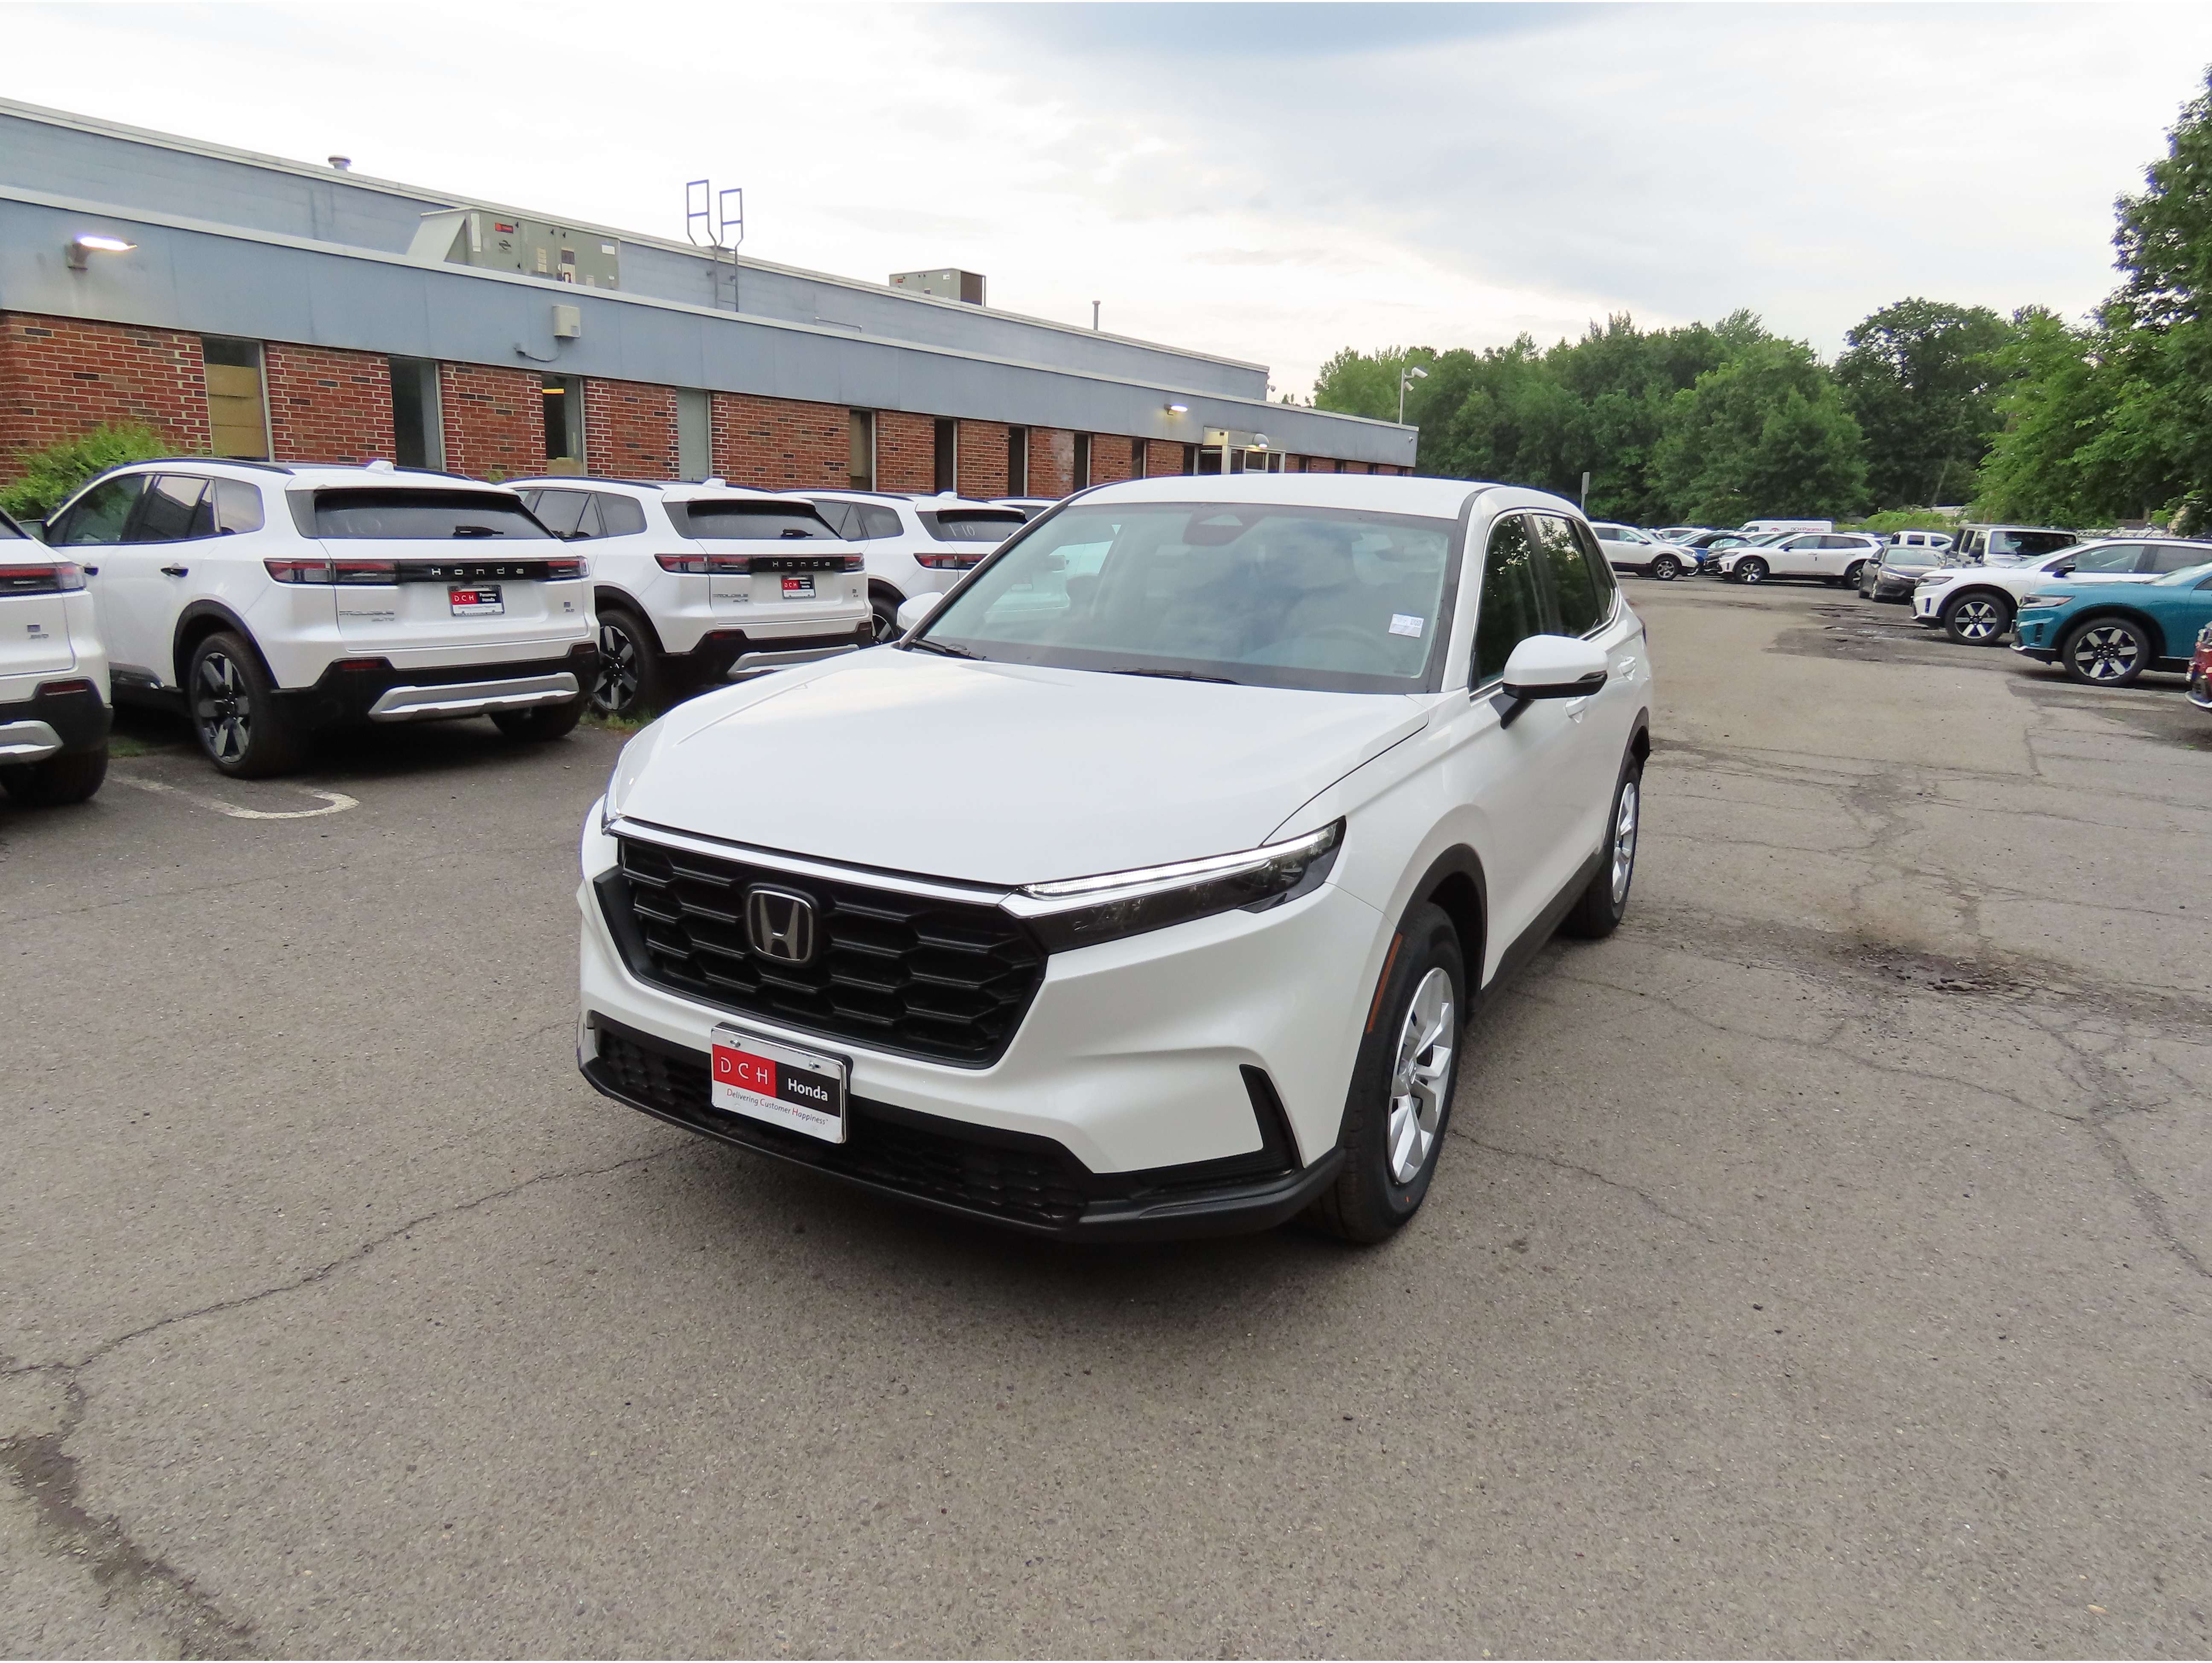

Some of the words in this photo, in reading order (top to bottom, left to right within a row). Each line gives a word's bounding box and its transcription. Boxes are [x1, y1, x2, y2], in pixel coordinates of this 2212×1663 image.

[720, 1056, 768, 1085] DCH
[727, 1088, 758, 1106] Delivering
[760, 1098, 791, 1114] Customer
[788, 1078, 829, 1102] Honda
